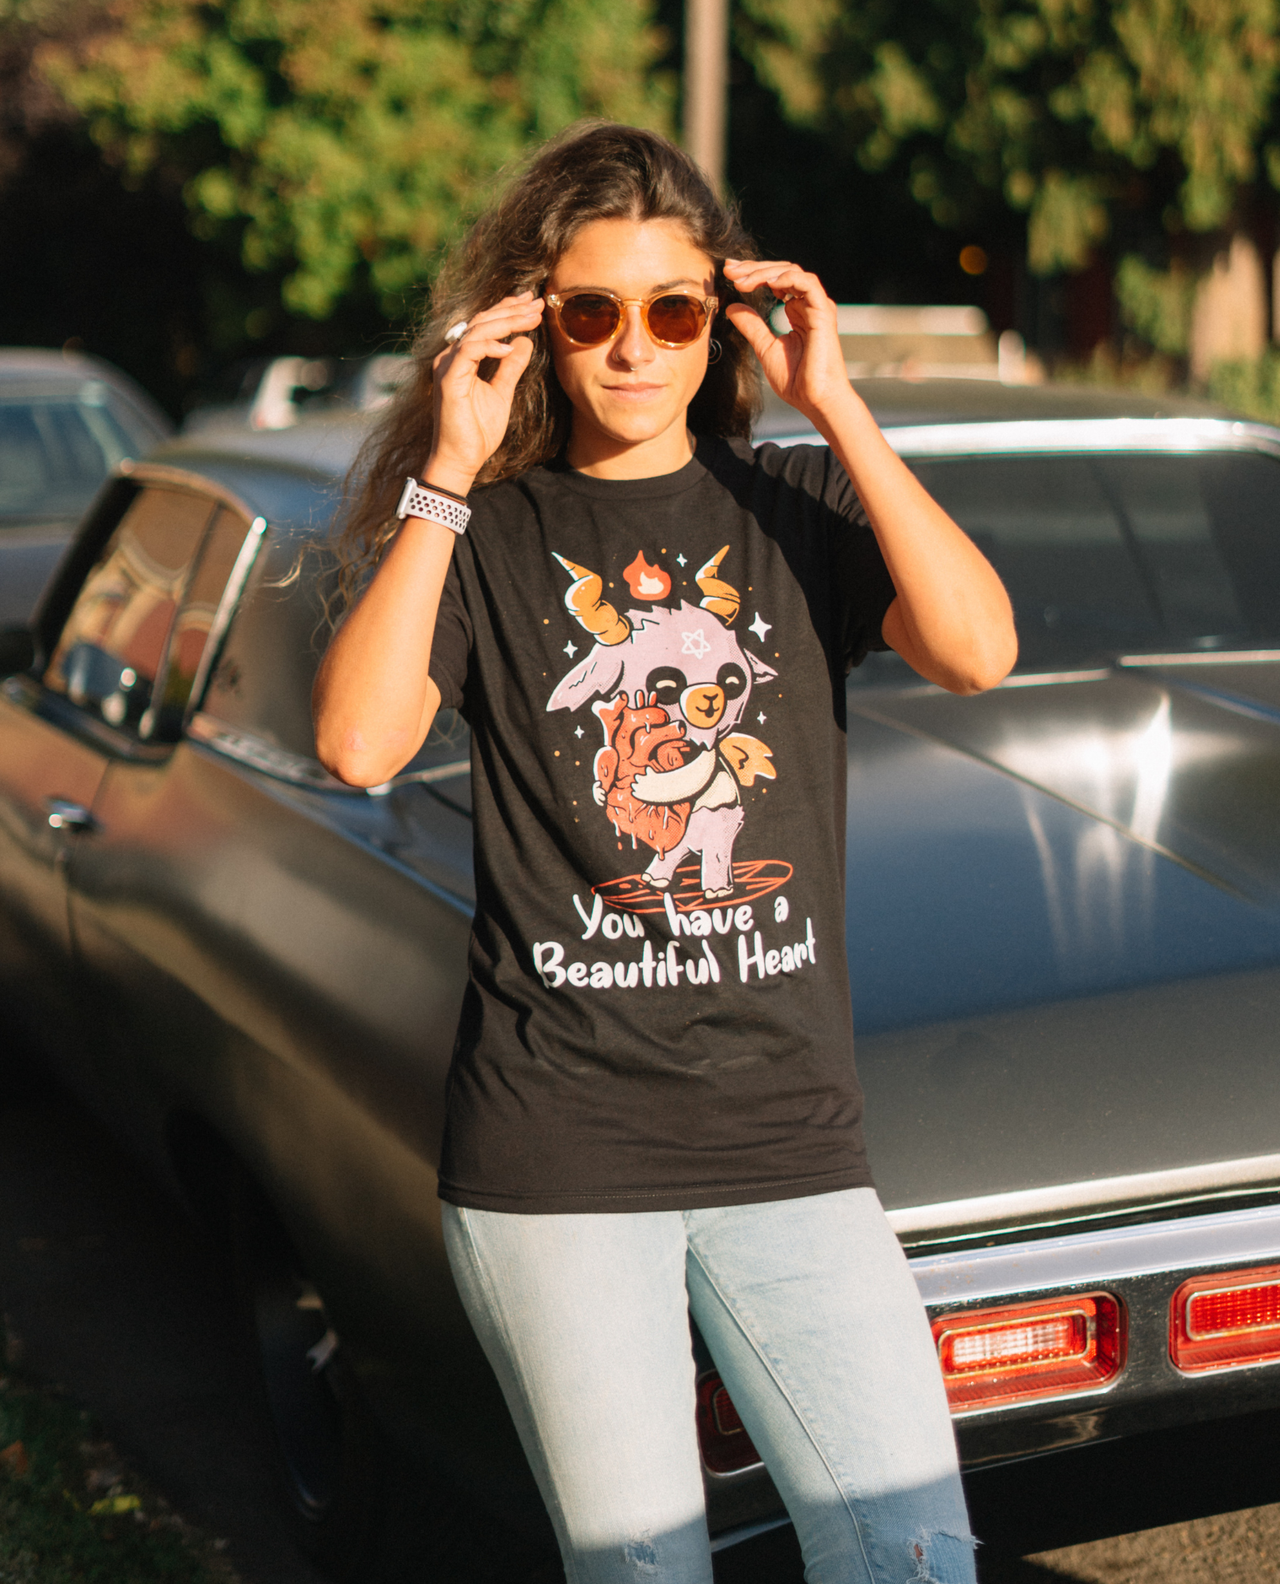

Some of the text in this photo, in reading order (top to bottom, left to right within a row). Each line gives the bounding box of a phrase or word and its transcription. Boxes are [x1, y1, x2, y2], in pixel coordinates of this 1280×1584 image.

[572, 892, 789, 940] You have a
[533, 917, 816, 989] Beautiful Heart
